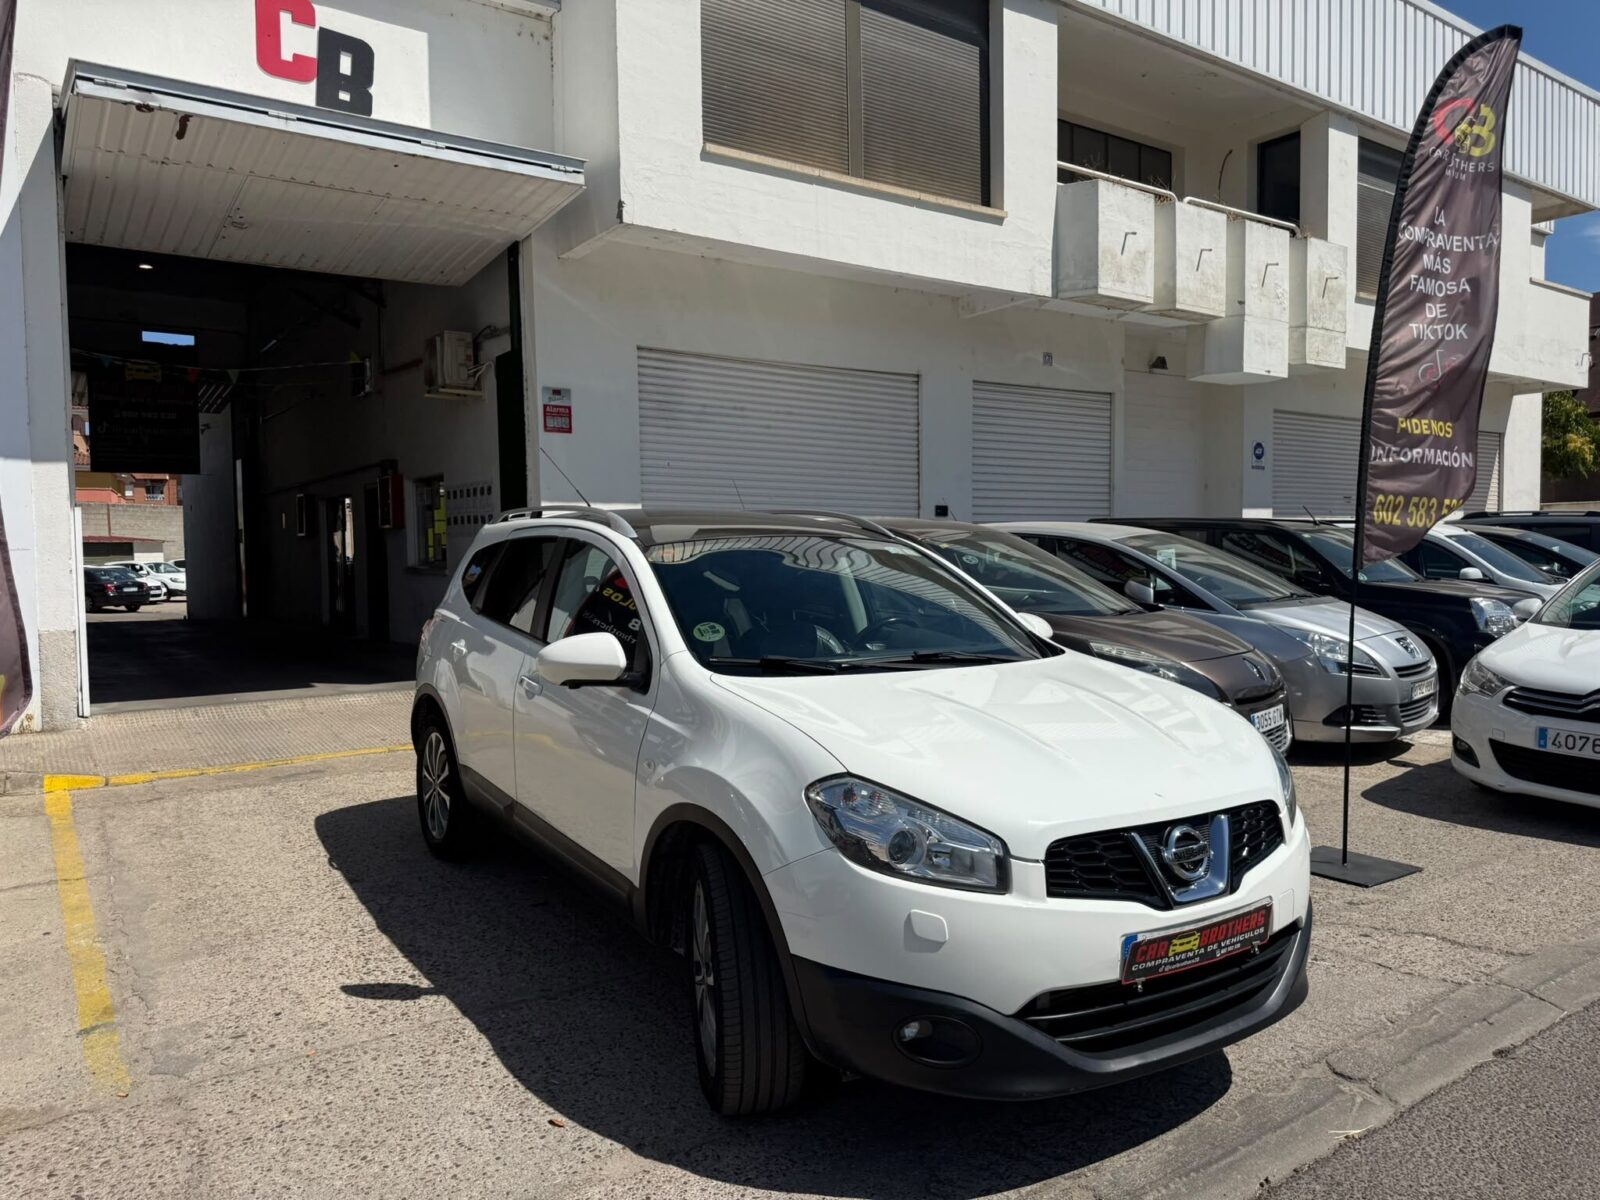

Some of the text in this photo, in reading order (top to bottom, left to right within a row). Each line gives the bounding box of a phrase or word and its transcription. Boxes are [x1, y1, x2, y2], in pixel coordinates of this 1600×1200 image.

[1434, 206, 1446, 226] LA
[1423, 252, 1451, 274] MÁS
[1410, 275, 1471, 297] FAMOSA
[1425, 303, 1447, 319] DE
[1409, 323, 1468, 340] TIKTOK
[1374, 494, 1404, 526] 602
[1407, 497, 1437, 528] 583
[1551, 732, 1600, 755] 4076
[1135, 911, 1265, 963] CAR BROTHERS
[1131, 948, 1205, 972] COMPRAVENTA
[1207, 943, 1218, 952] DE
